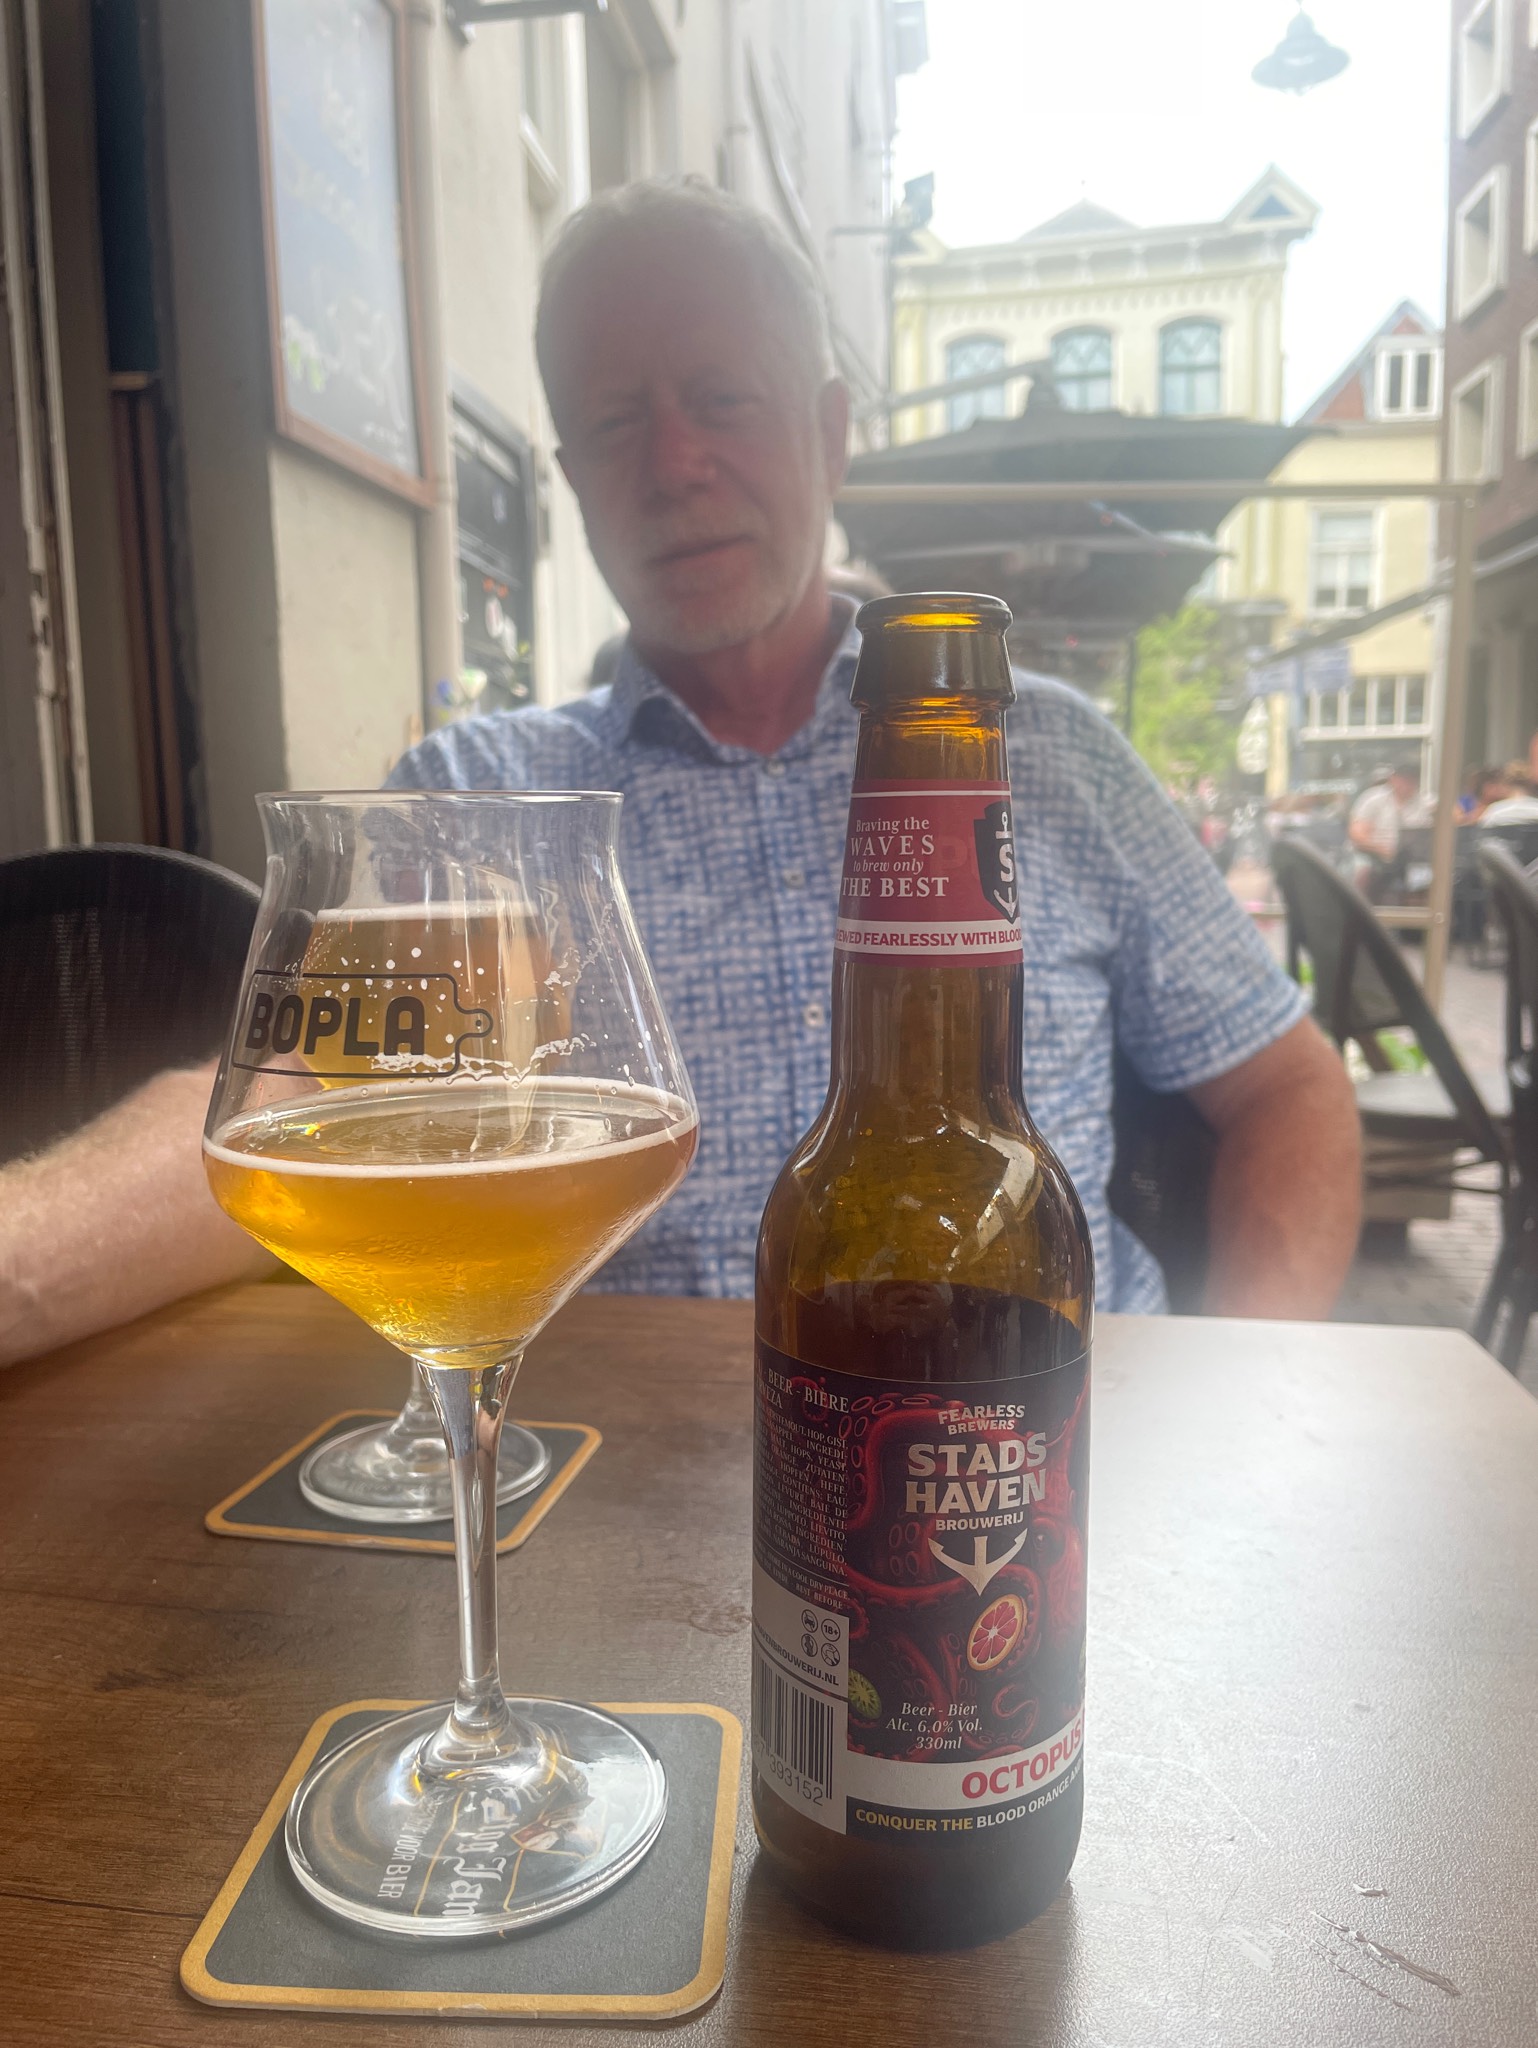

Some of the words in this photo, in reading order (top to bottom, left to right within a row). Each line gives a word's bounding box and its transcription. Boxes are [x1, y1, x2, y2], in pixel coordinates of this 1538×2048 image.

[856, 818, 900, 834] Braving
[904, 816, 930, 830] the
[850, 834, 935, 857] WAVES
[853, 859, 862, 872] to
[862, 860, 890, 872] brew
[893, 858, 924, 875] only
[842, 876, 871, 897] THE
[880, 876, 949, 898] BEST
[863, 932, 957, 947] FEARLESSLY
[961, 932, 997, 946] WITH
[245, 992, 426, 1056] BOPLA
[768, 1367, 793, 1396] BEER
[804, 1385, 849, 1414] BIÈRE
[938, 1404, 1026, 1425] FEARLESS
[947, 1418, 1015, 1435] BREWERS
[907, 1432, 1047, 1477] STADS
[905, 1468, 1046, 1514] HAVEN
[835, 1507, 848, 1519] DE
[935, 1511, 1024, 1532] BROUWERIJ
[823, 1624, 839, 1636] 18+
[901, 1702, 935, 1717] Beer
[947, 1702, 978, 1717] Bier
[886, 1718, 912, 1732] Alc.
[957, 1718, 982, 1733] Vol.
[914, 1736, 962, 1750] 330ml
[961, 1718, 1082, 1800] OCTOPUS
[769, 1755, 824, 1807] 393152
[855, 1808, 937, 1832] CONQUER
[941, 1817, 973, 1832] THE
[975, 1805, 1026, 1829] BLOOD
[1028, 1775, 1070, 1813] ORANGE
[391, 1834, 424, 1861] VOOR
[377, 1864, 411, 1899] BIER
